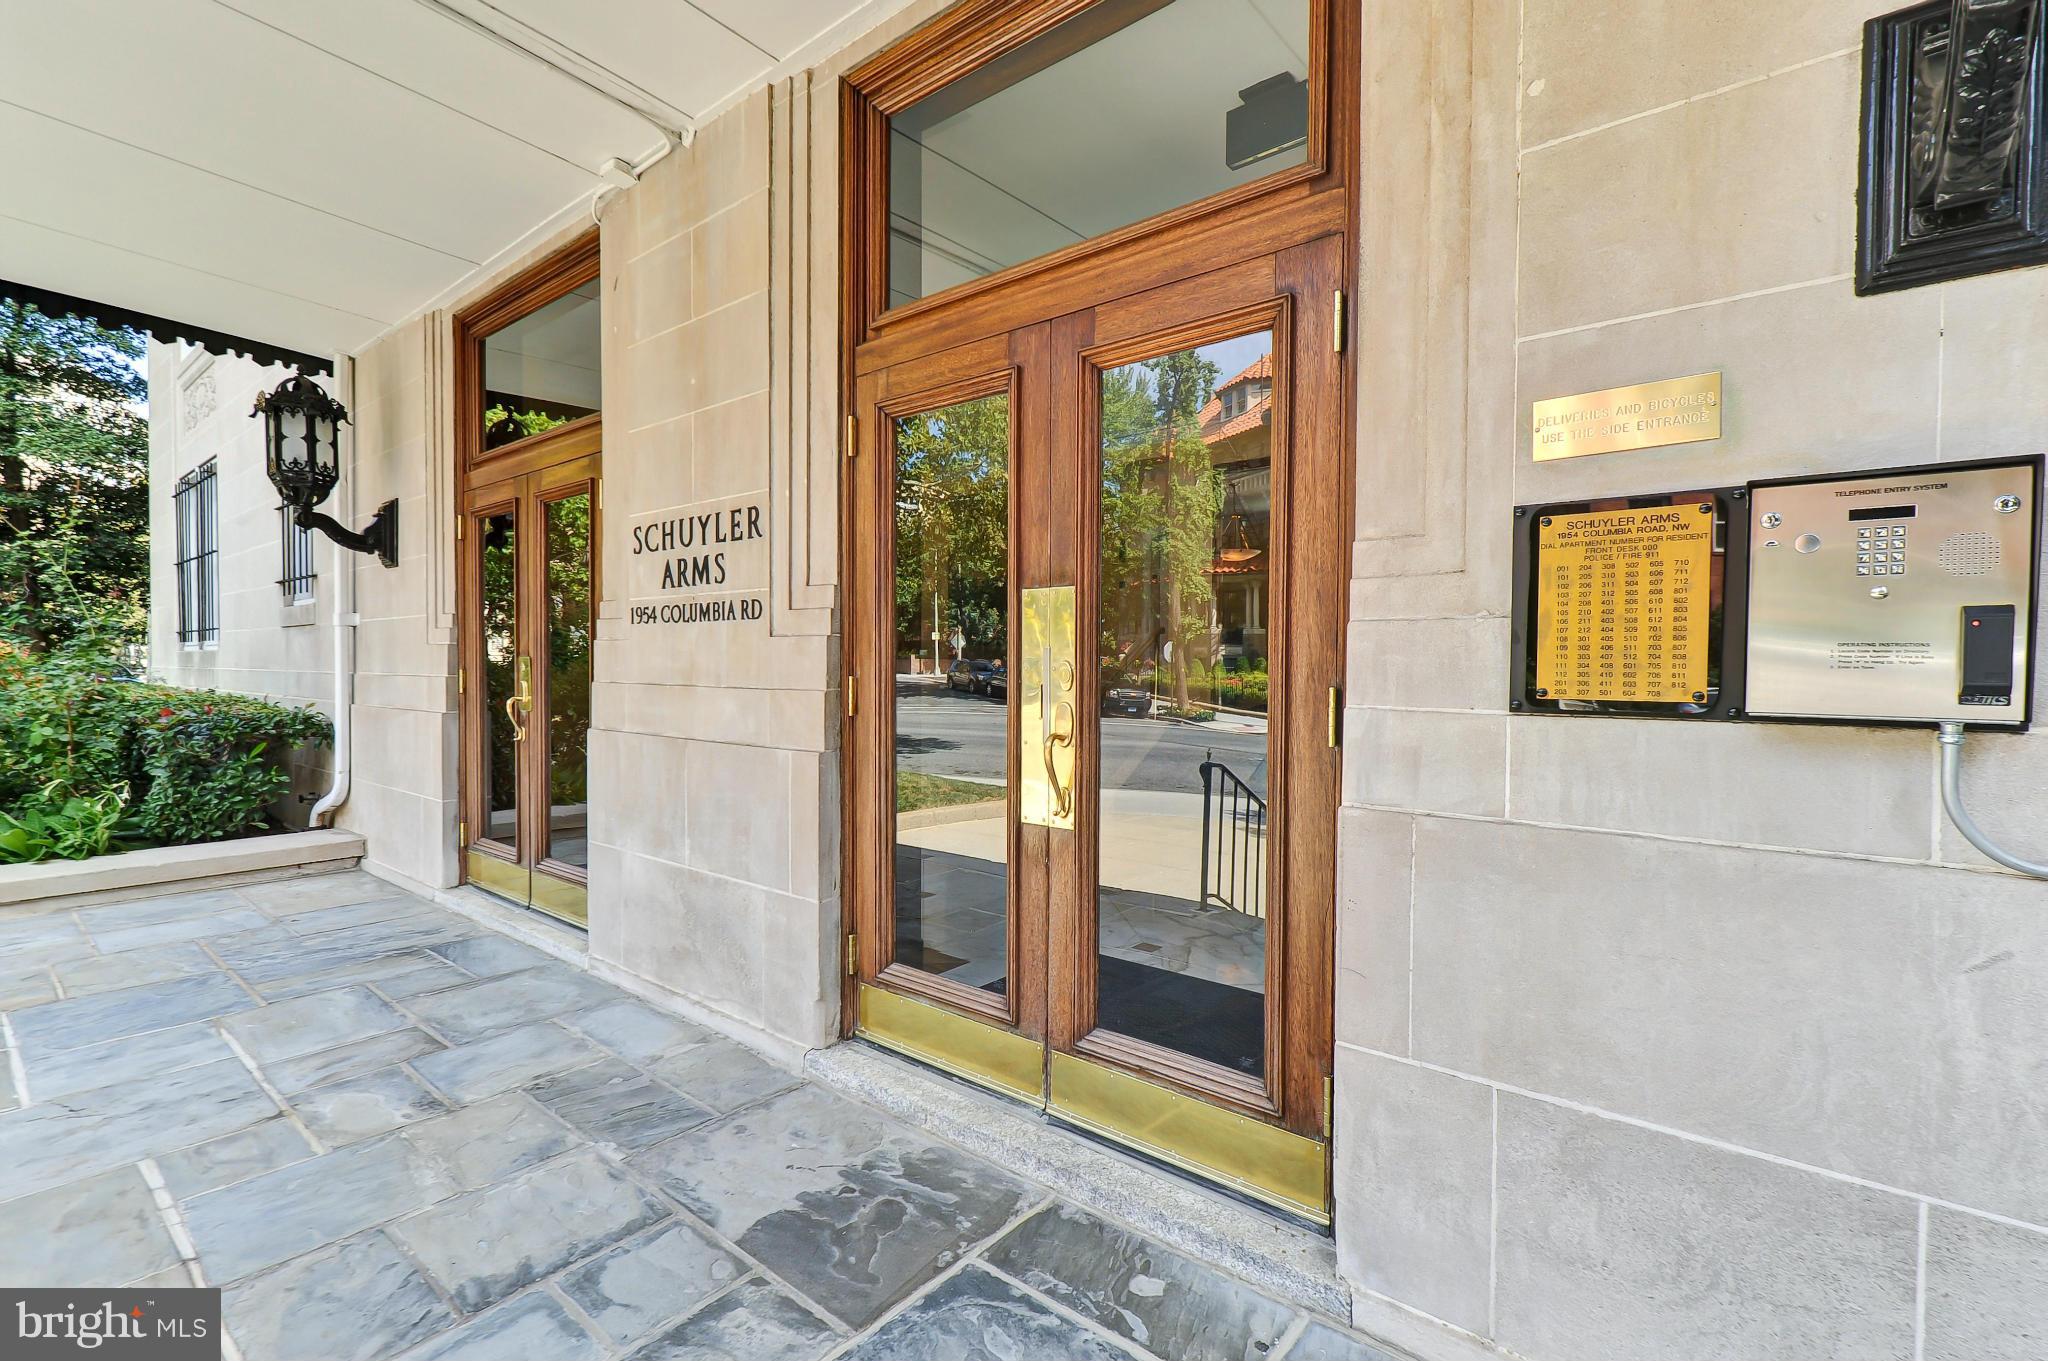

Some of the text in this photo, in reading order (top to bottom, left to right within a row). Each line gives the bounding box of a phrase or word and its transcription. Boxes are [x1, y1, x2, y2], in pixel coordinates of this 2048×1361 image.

[1538, 392, 1715, 428] DELIVERIES AND BICYCLES
[1542, 412, 1710, 444] USE THE SIDE ENTRANCE
[1834, 488, 1882, 497] TELEPHONE
[1913, 483, 1948, 491] SYSTEM
[633, 505, 763, 555] SCHUYLER
[1557, 531, 1578, 539] 1954
[1582, 528, 1633, 538] COLUMBIA
[1672, 523, 1691, 531] NW
[1566, 512, 1680, 530] SCHUYLER ARMS
[1560, 540, 1606, 548] APARTMENT
[1609, 537, 1644, 545] NUMBER
[1666, 532, 1709, 541] RESIDENT
[661, 552, 726, 590] ARMS
[630, 598, 762, 624] 1954 COLUMBIA RD
